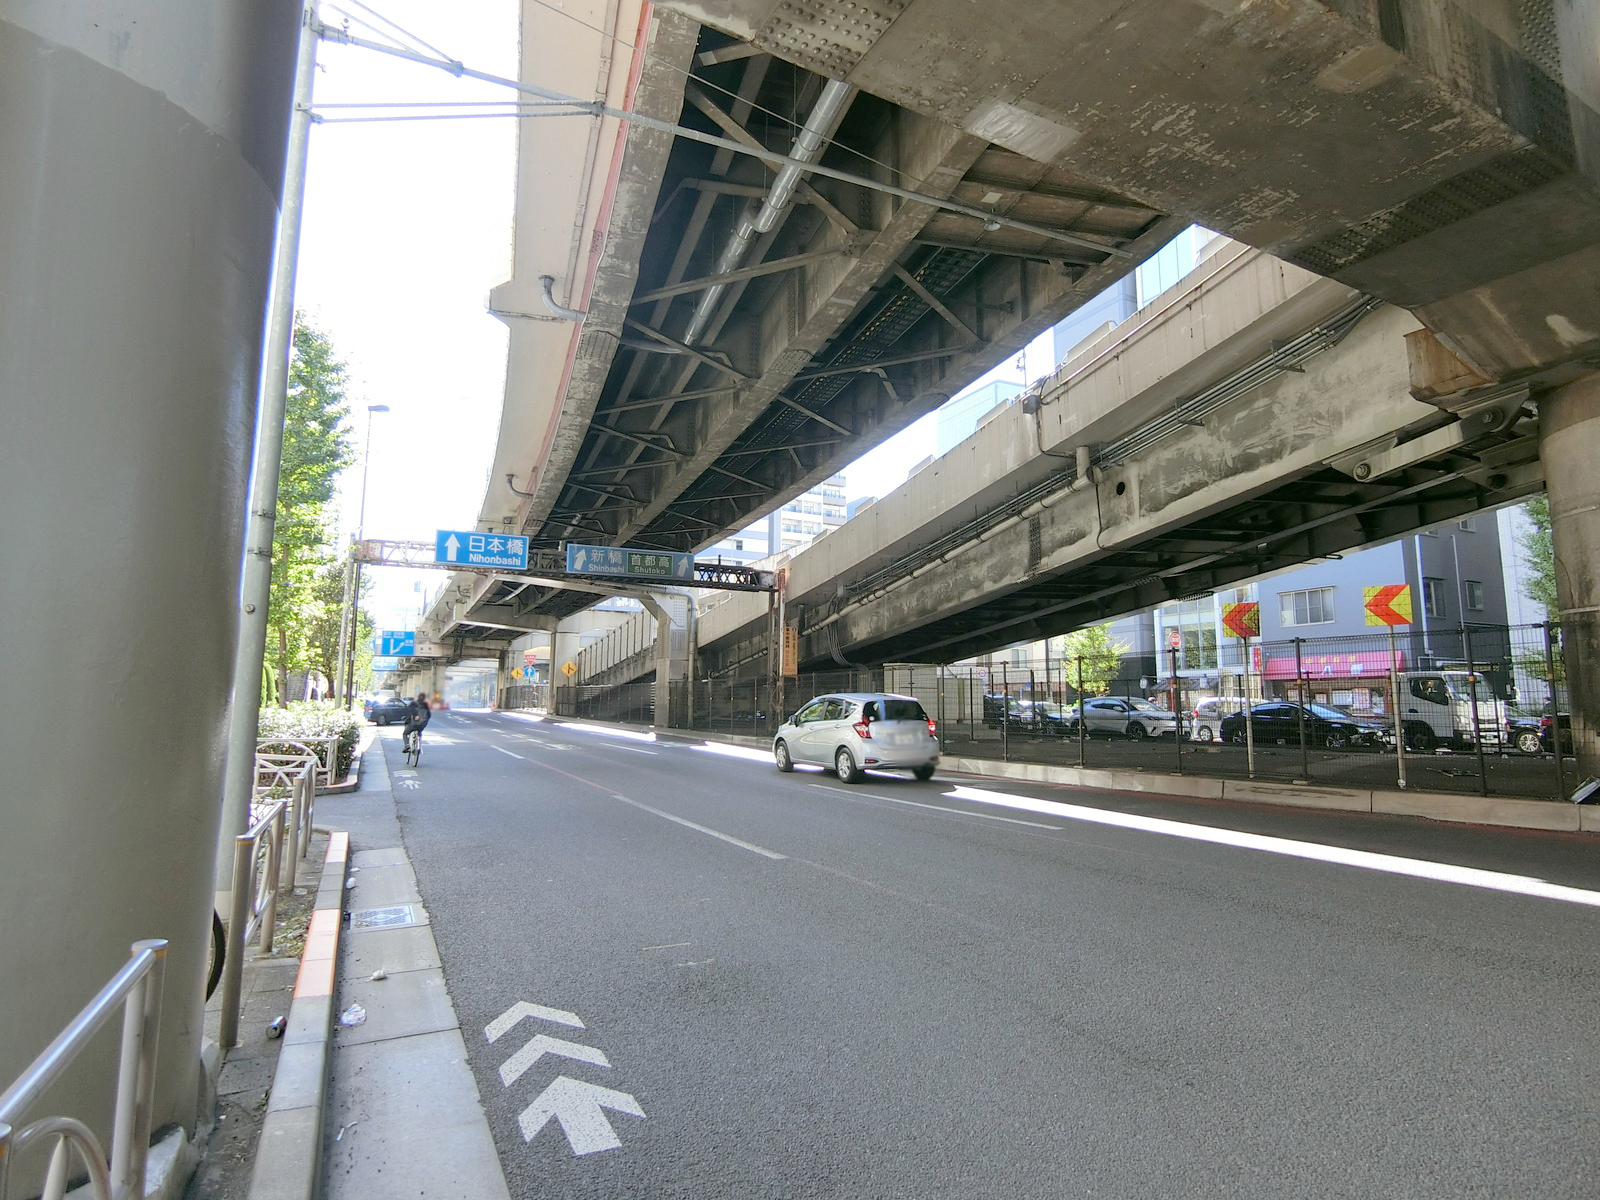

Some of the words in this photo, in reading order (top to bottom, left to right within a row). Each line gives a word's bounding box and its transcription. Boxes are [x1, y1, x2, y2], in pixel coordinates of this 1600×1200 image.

[469, 535, 523, 555] 日本橋
[469, 553, 521, 566] Nihonbashi
[590, 549, 623, 564] 新橋
[630, 554, 670, 568] 首都高
[588, 563, 625, 574] Shinbashi
[634, 565, 666, 575] Shutoko
